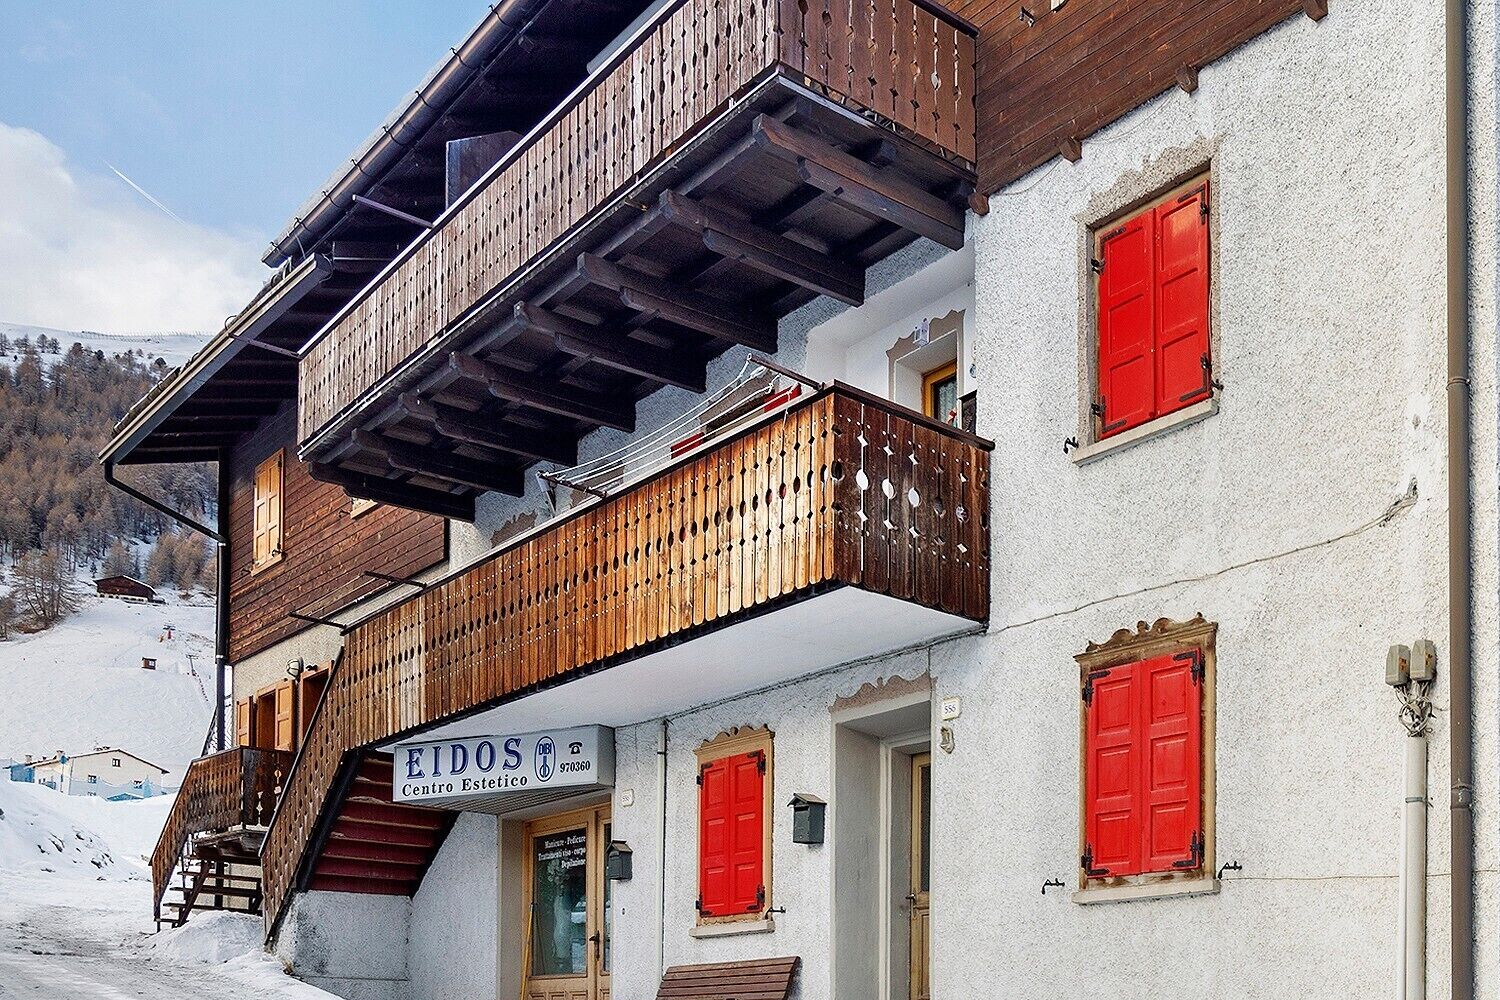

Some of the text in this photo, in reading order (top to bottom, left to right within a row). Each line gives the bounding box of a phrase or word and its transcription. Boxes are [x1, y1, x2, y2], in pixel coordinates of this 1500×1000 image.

[406, 737, 523, 780] EIDOS
[560, 760, 591, 773] 970360
[402, 774, 528, 797] Centro Estetico
[567, 835, 586, 844] Pedicure
